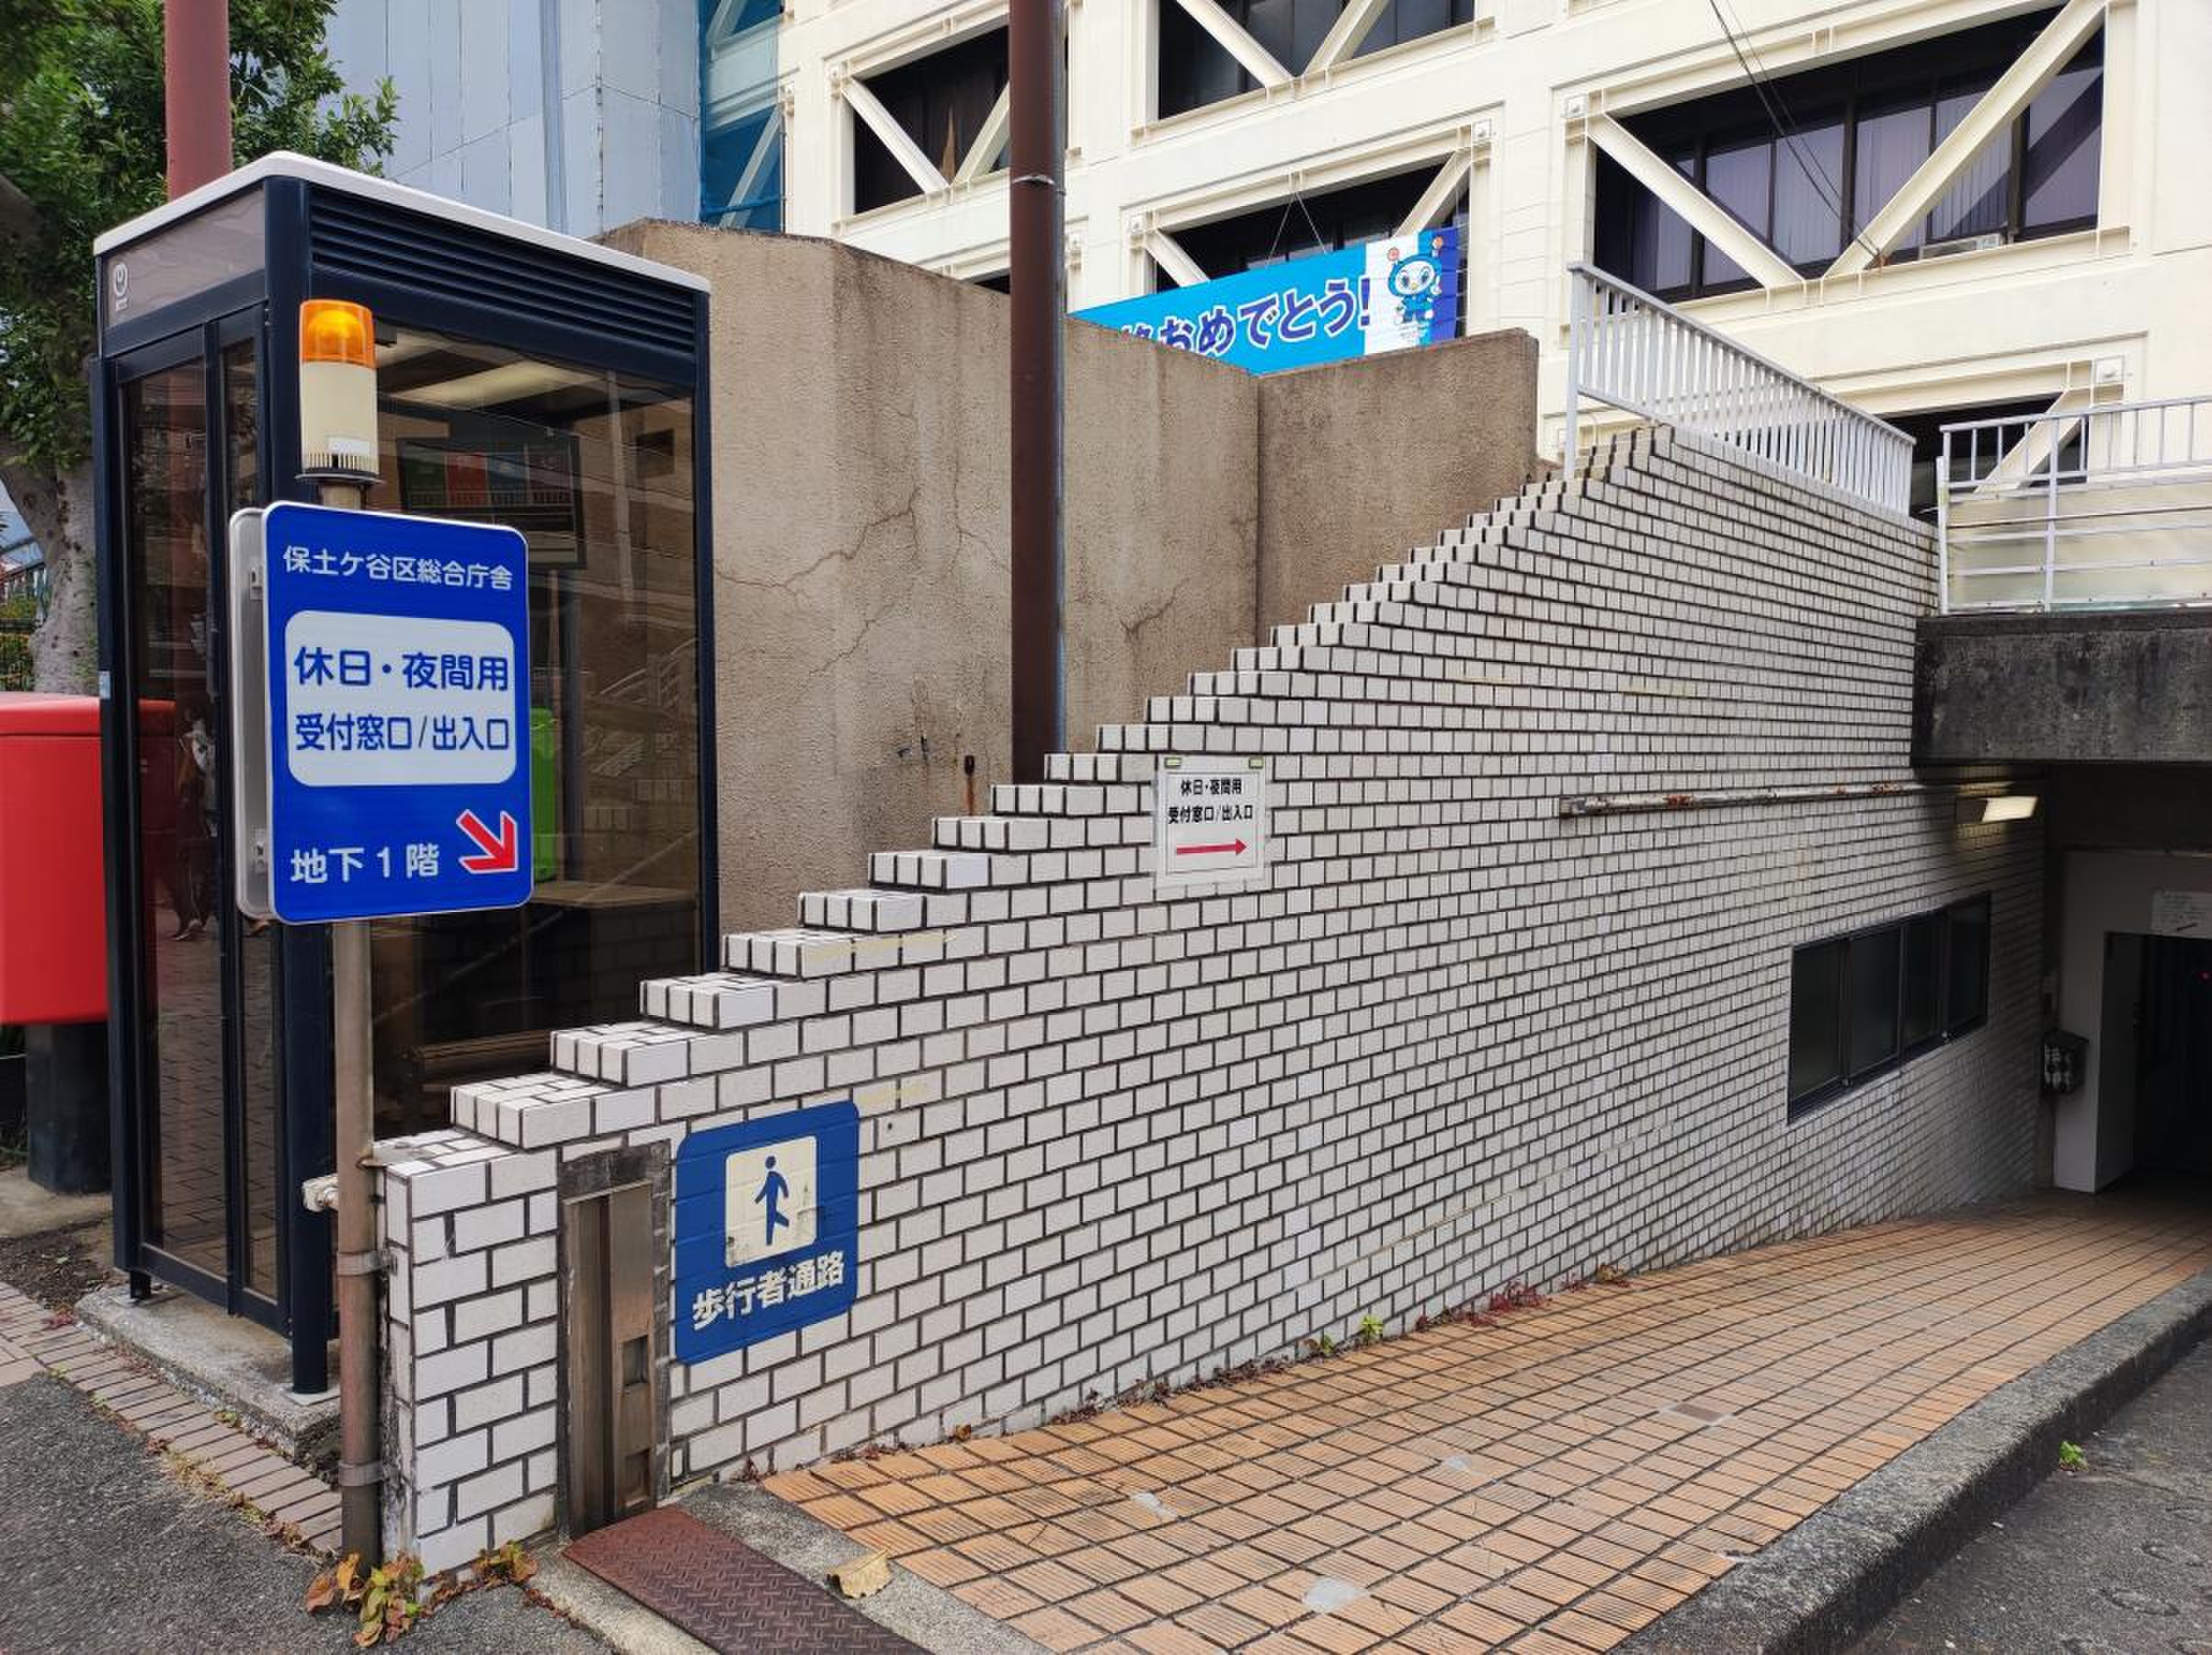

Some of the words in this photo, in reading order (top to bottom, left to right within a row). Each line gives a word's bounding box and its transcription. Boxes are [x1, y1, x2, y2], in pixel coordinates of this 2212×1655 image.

[1121, 276, 1372, 357] おめでとう!
[283, 545, 513, 590] 保土ケ谷区総合庁舎
[293, 646, 508, 692] 休日・夜間用
[295, 713, 509, 751] 受付窓口/出入口
[1180, 779, 1242, 795] 休日・夜間用
[692, 1250, 844, 1330] 歩行者通路
